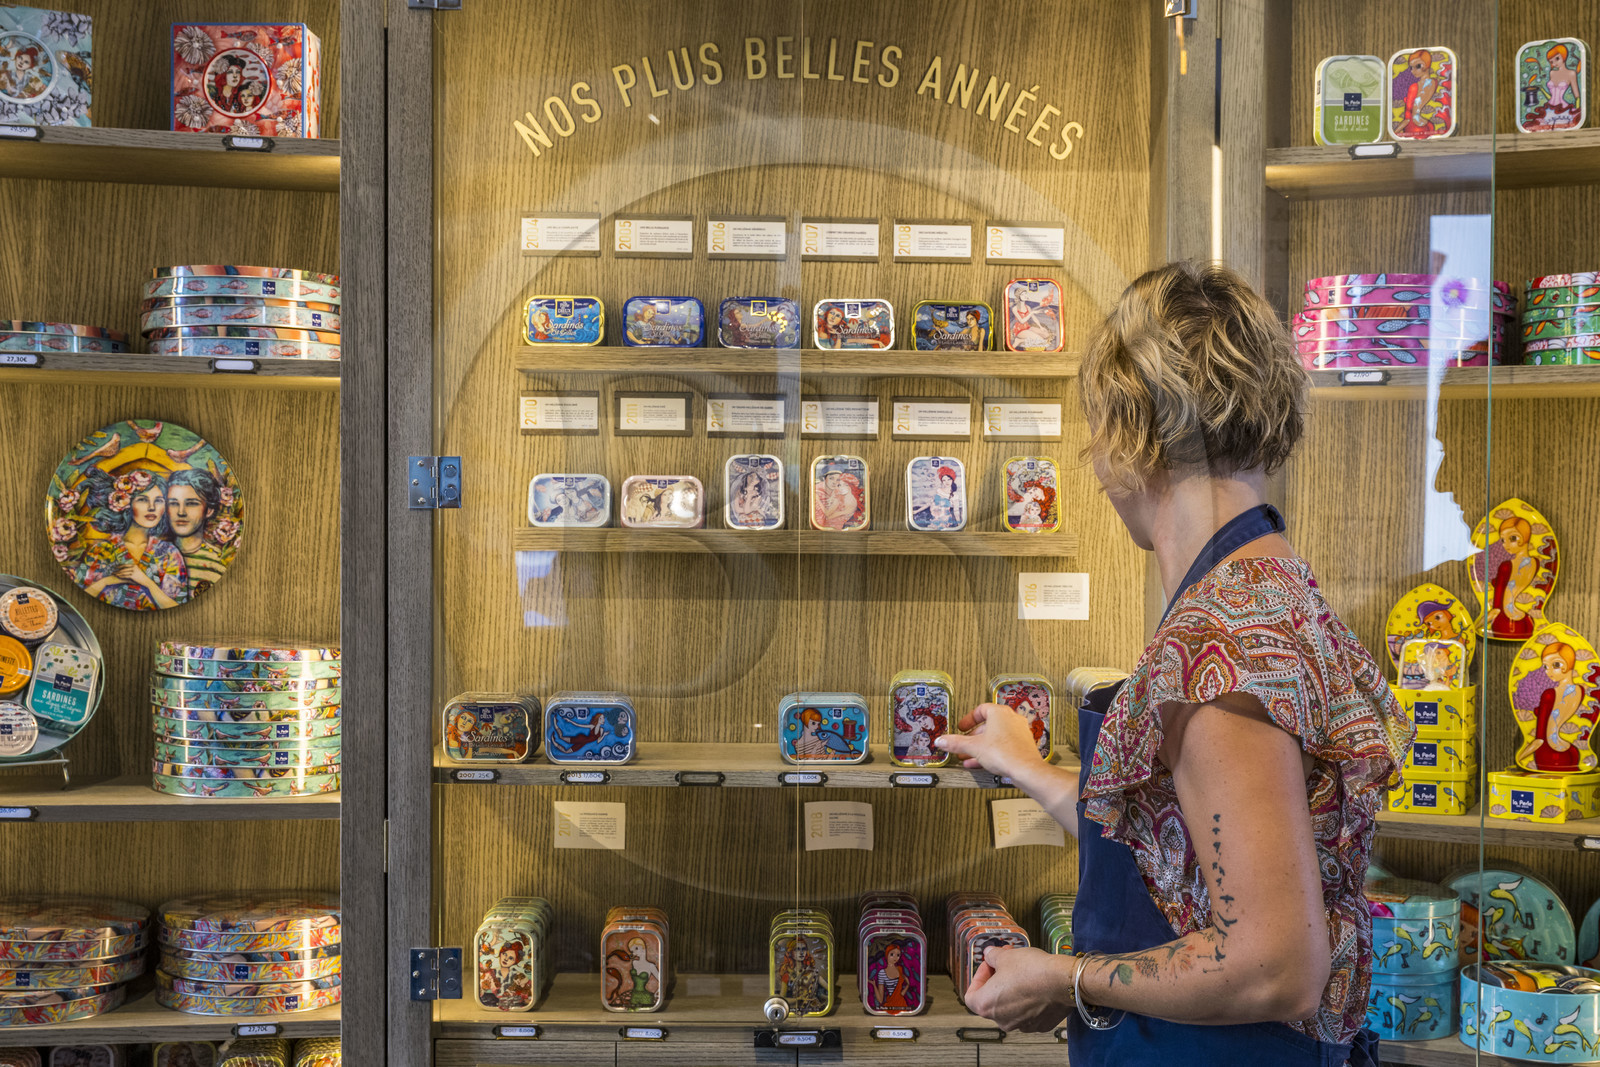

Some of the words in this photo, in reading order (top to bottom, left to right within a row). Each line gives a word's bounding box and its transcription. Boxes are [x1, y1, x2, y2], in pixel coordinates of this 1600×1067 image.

[513, 81, 602, 157] NOS
[612, 42, 723, 107] PLUS
[745, 36, 903, 88] BELLES
[917, 55, 1084, 160] ANNÉES
[1334, 115, 1370, 126] SARDINES
[526, 218, 539, 249] 2004
[618, 220, 632, 250] 2005
[712, 222, 725, 252] 2006
[805, 224, 819, 253] 2007
[898, 225, 911, 255] 2008
[990, 227, 1004, 257] 2009
[545, 318, 584, 330] Sardines
[835, 324, 874, 335] Sardines
[933, 329, 973, 341] Sardines
[524, 398, 538, 425] 2010
[626, 403, 638, 424] 2011
[711, 401, 724, 428] 2012
[805, 403, 818, 430] 2013
[897, 404, 911, 431] 2014
[988, 405, 1002, 432] 2015
[1024, 583, 1038, 608] 2016
[41, 690, 77, 706] SARDINES
[467, 730, 509, 743] Sardines
[558, 811, 572, 837] 2017
[810, 811, 823, 839] 2018
[997, 810, 1011, 837] 2019
